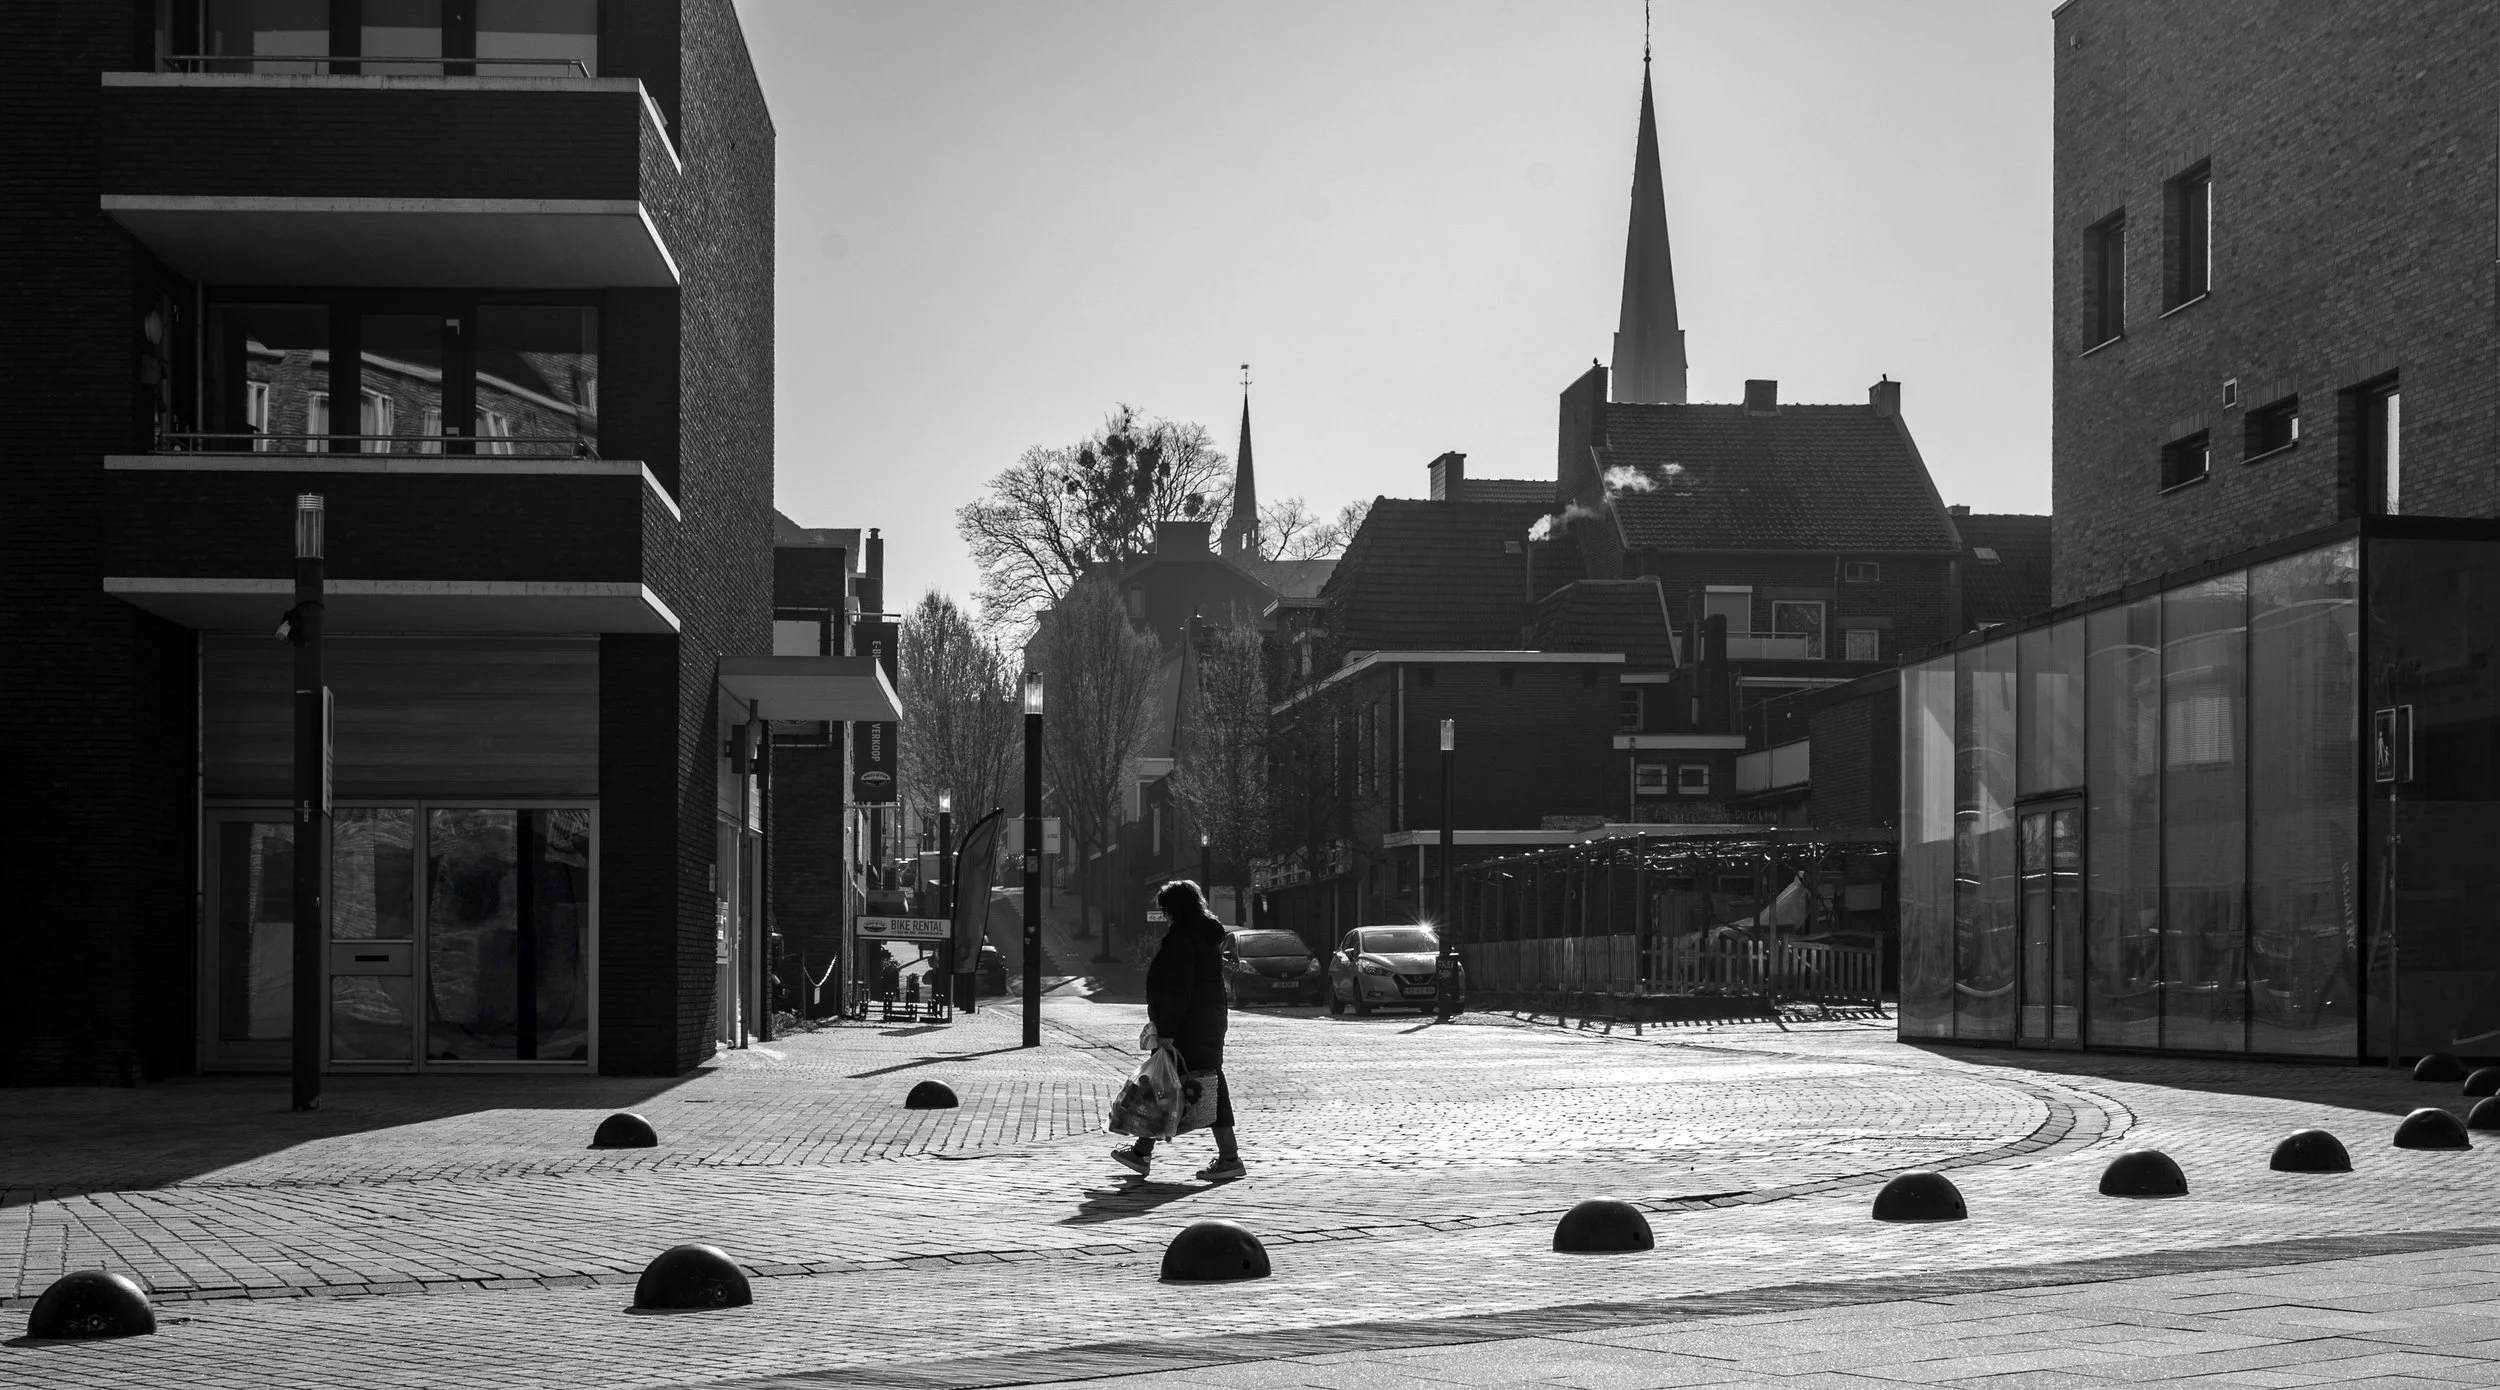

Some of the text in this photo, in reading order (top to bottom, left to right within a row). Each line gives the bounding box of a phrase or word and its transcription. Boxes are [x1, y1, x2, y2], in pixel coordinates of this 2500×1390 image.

[872, 640, 882, 661] E-BI
[871, 723, 881, 762] VERKOOP
[891, 919, 910, 931] BIKE
[912, 920, 944, 932] RENTAL
